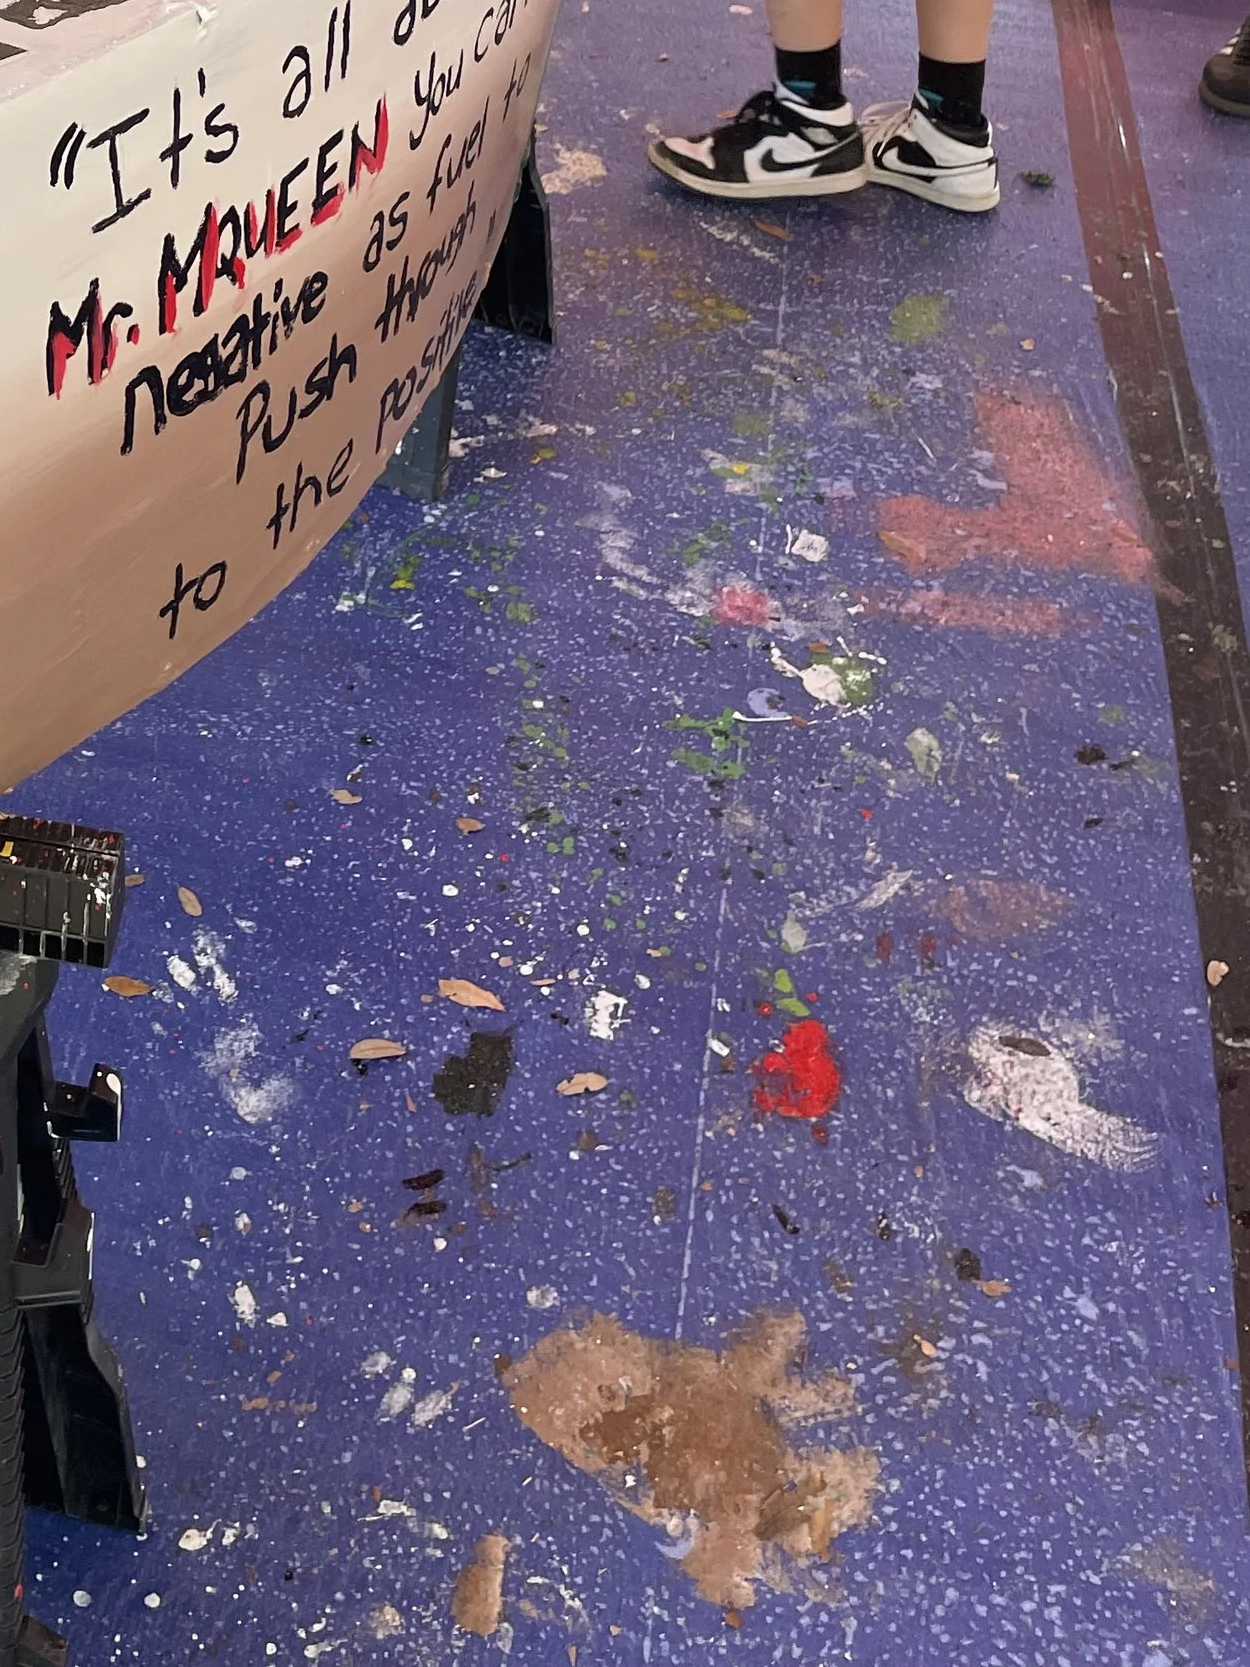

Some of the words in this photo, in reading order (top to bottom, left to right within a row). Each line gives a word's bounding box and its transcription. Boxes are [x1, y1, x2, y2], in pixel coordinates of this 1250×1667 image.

[49, 66, 240, 234] "It's
[281, 0, 351, 120] all
[361, 190, 411, 274] as
[426, 94, 491, 216] fuel
[502, 51, 532, 123] to
[45, 276, 141, 400] Mr.
[158, 560, 229, 640] to
[265, 438, 354, 551] the
